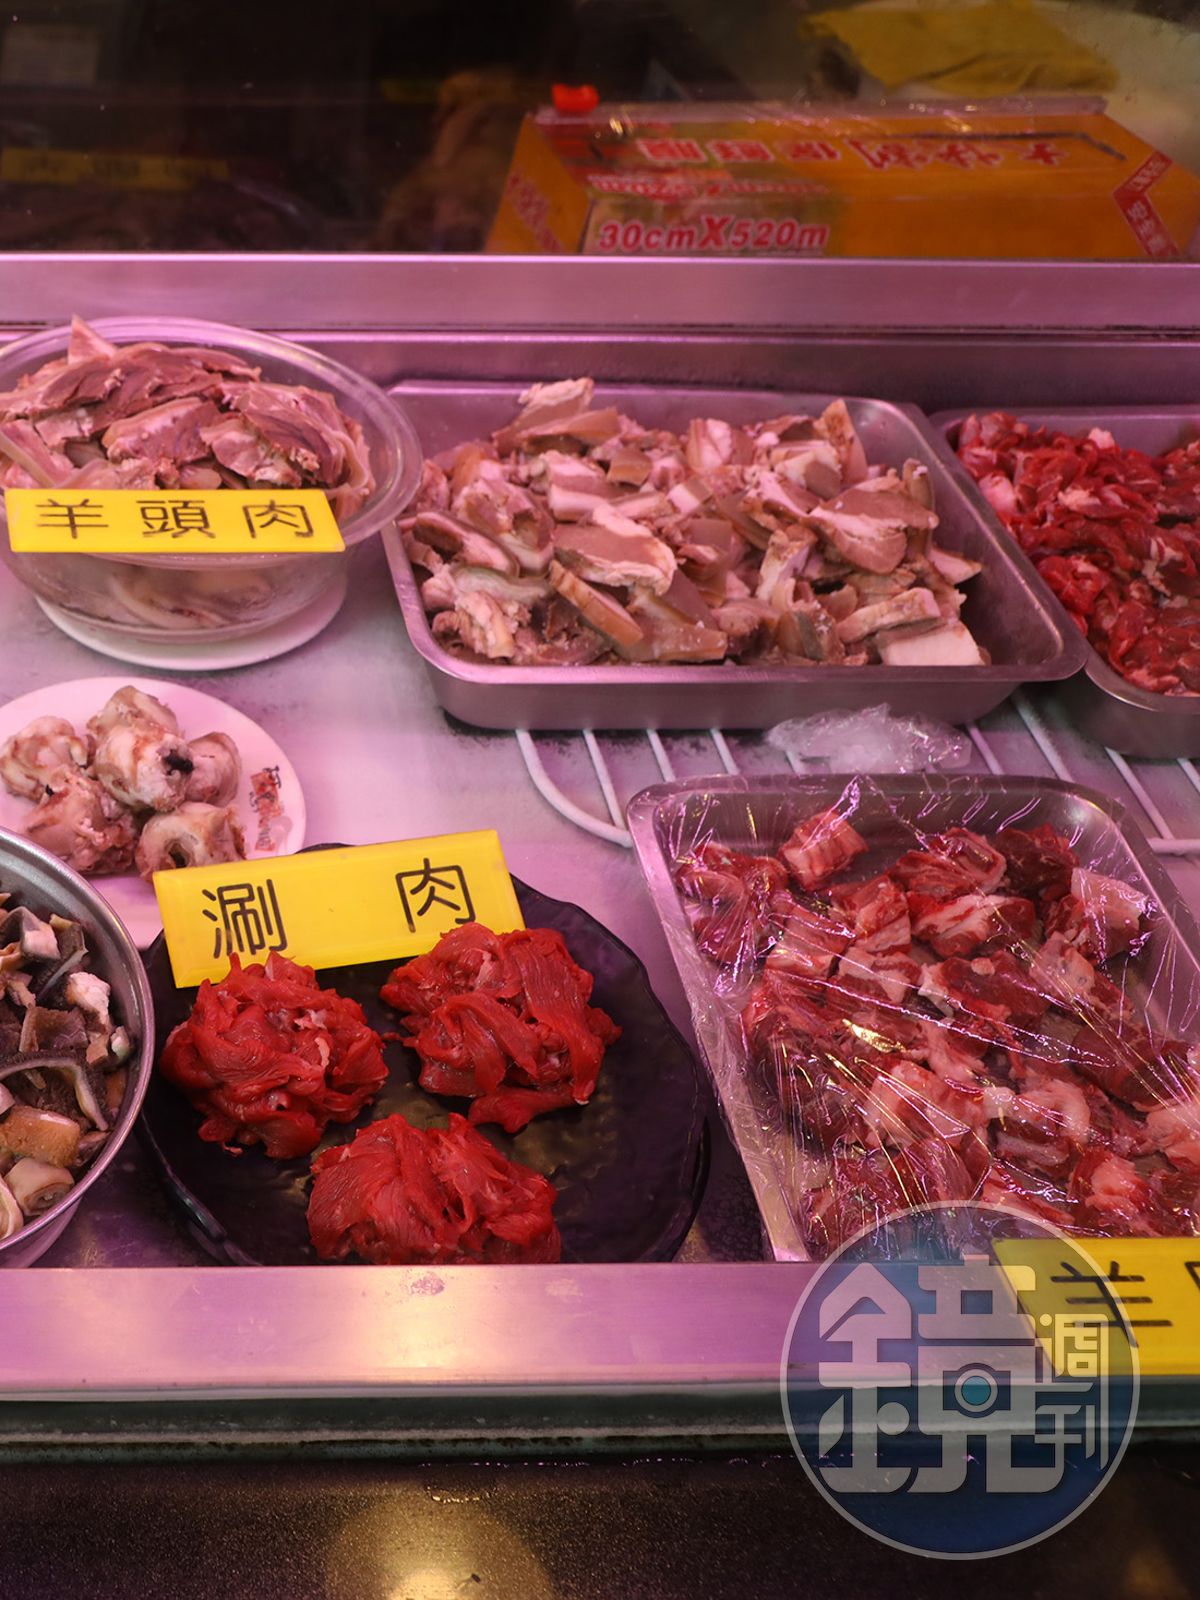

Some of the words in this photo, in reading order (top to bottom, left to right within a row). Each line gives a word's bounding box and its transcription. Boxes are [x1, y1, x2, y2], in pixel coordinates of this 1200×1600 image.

[35, 499, 316, 539] 羊頭肉
[202, 858, 476, 959] 涮肉
[1051, 1261, 1200, 1348] 羊
